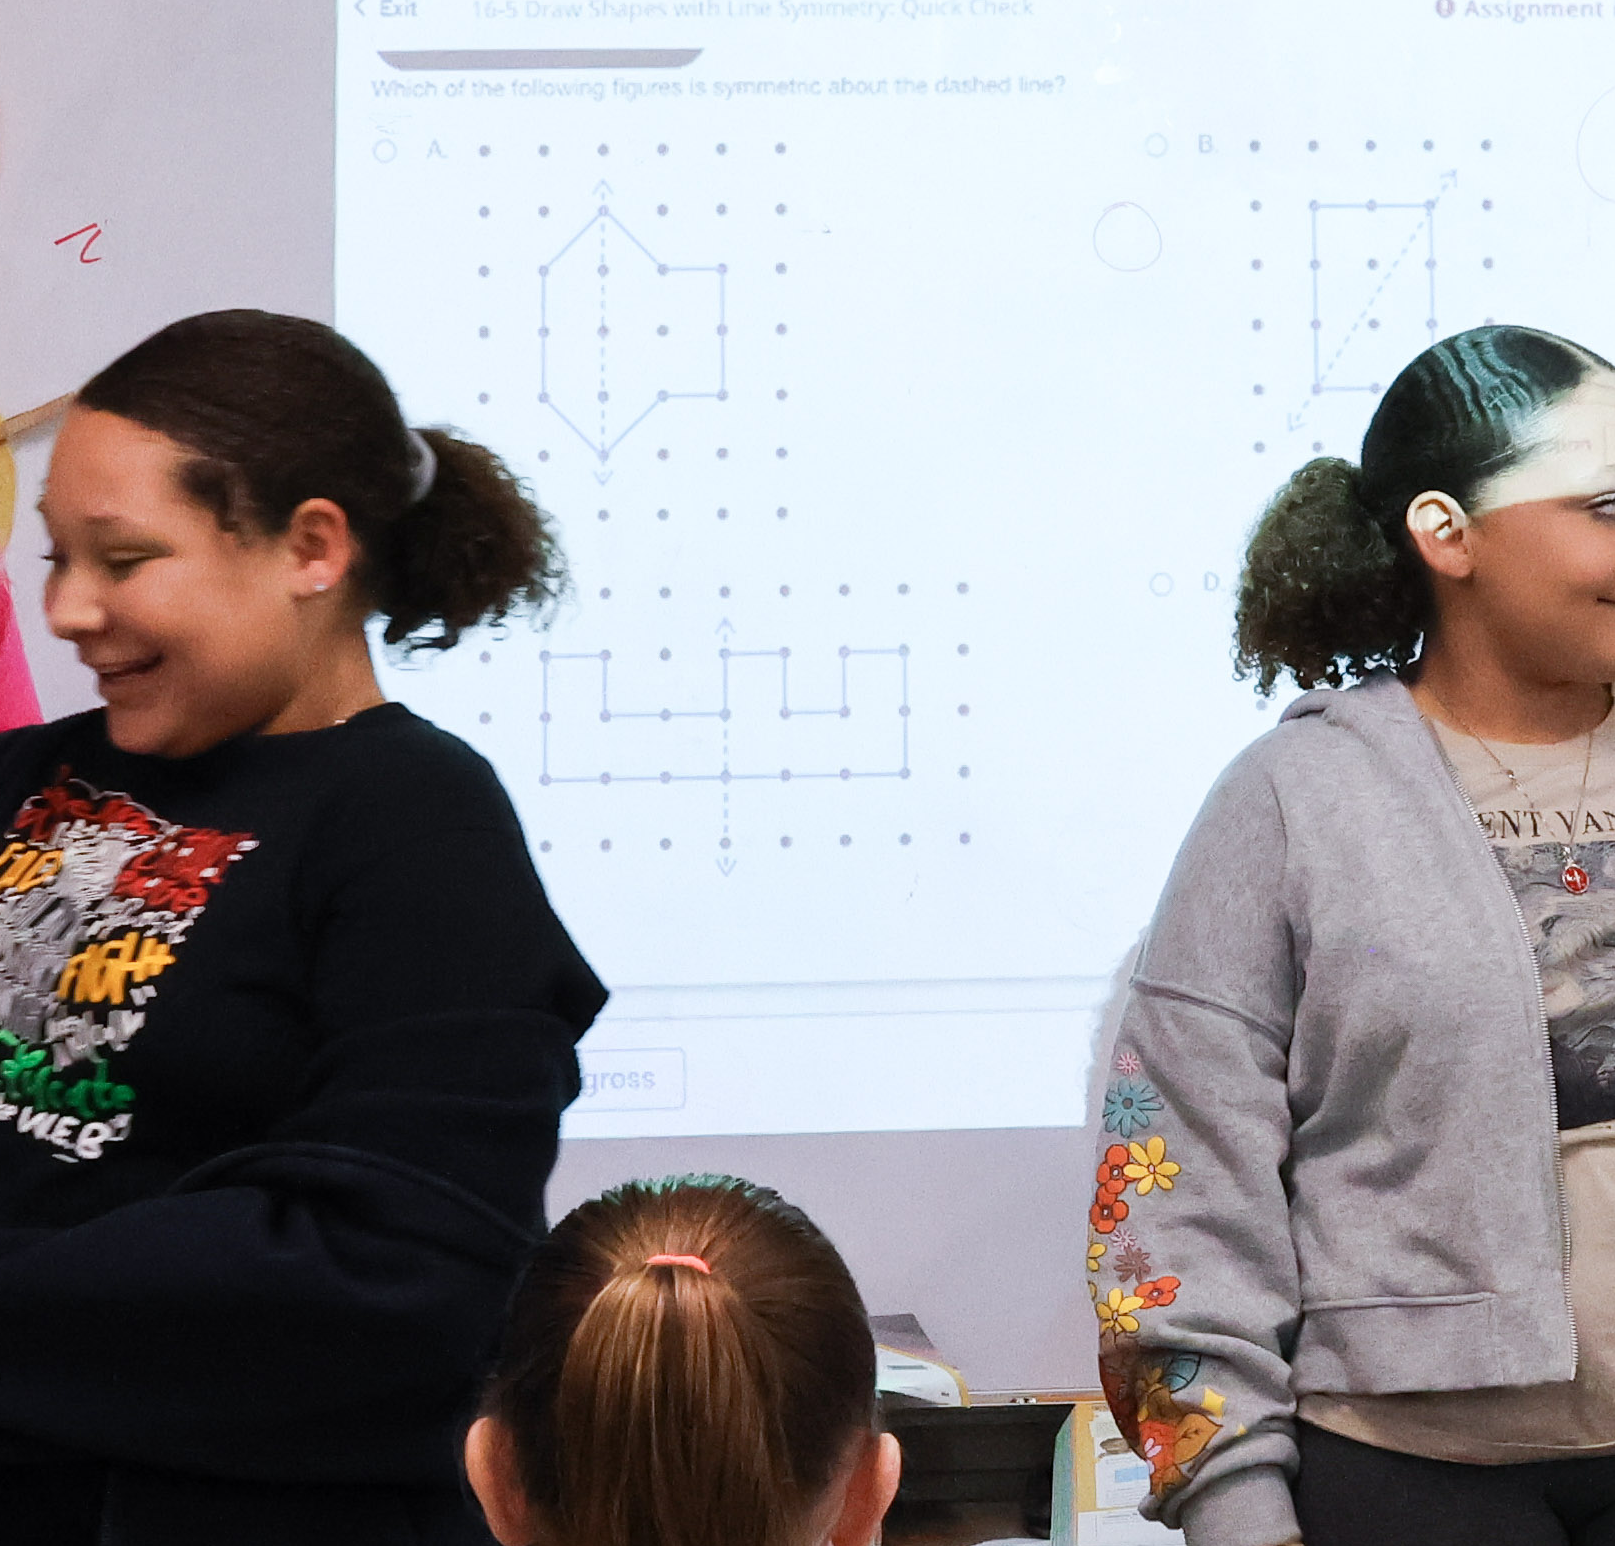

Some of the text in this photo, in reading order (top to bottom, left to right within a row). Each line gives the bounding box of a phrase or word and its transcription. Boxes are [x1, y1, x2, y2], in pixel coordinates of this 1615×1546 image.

[1462, 0, 1604, 22] Assignment
[370, 74, 1067, 102] Which of the following figures is symmetric about the dashed line?
